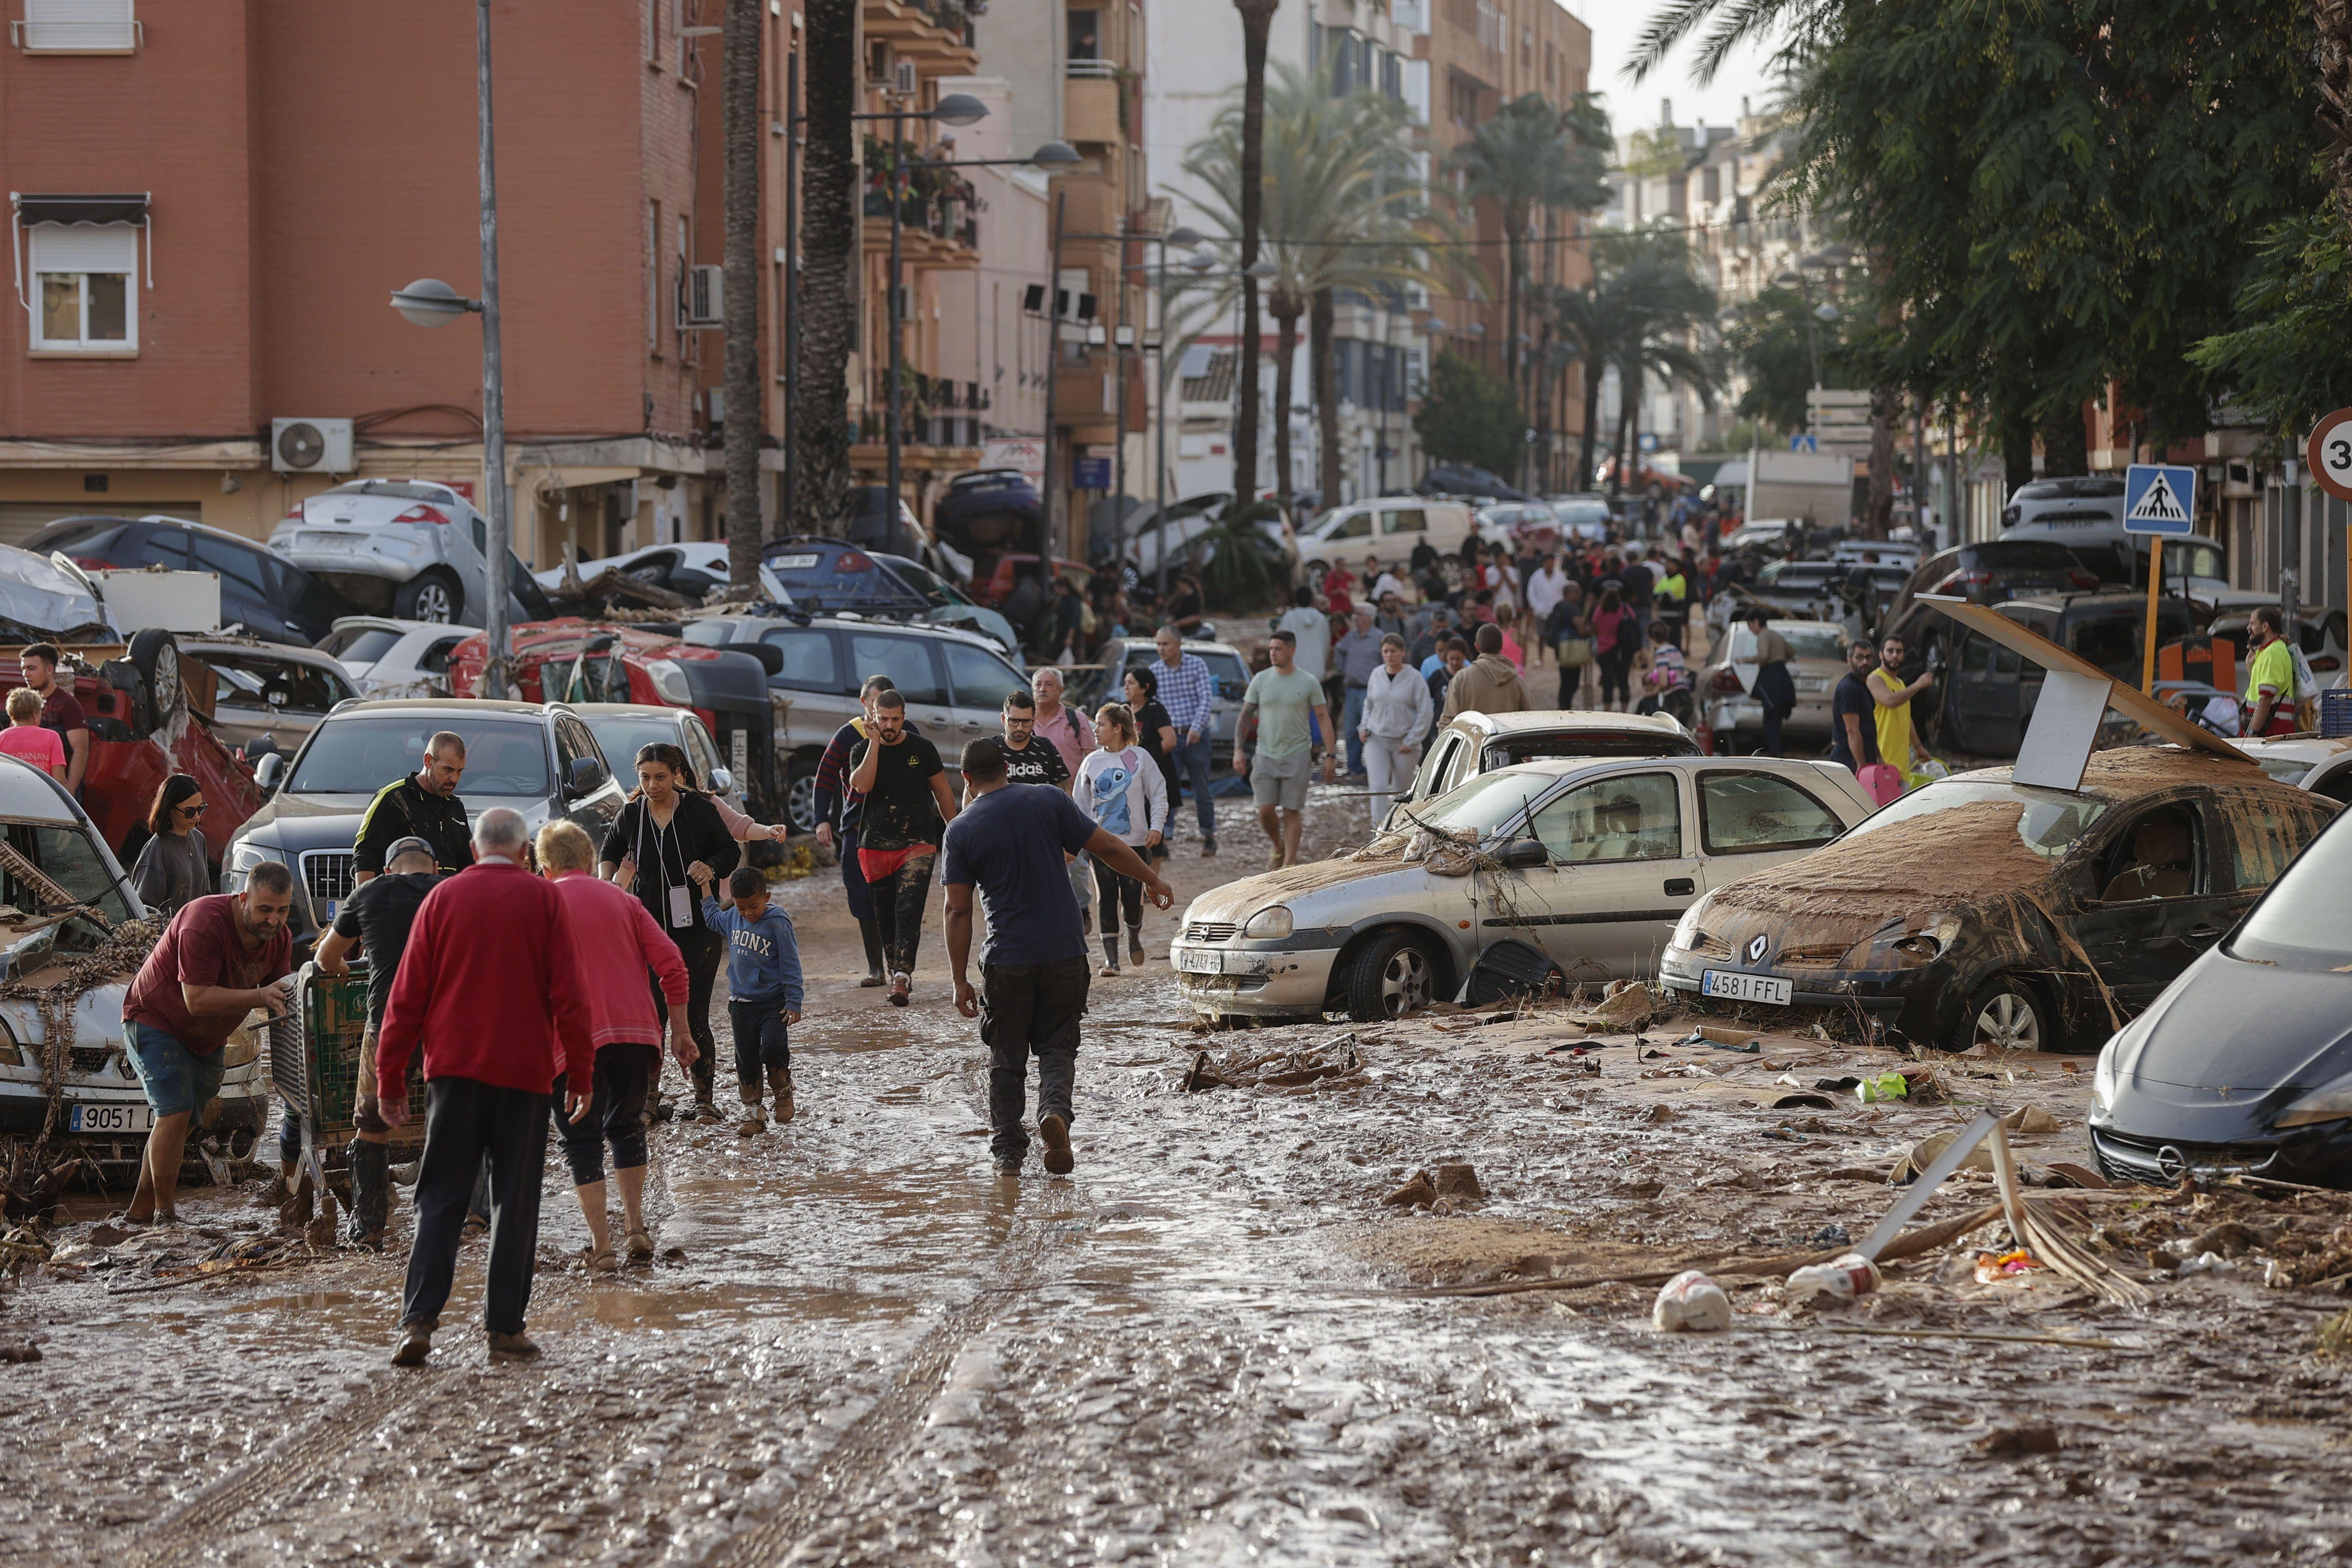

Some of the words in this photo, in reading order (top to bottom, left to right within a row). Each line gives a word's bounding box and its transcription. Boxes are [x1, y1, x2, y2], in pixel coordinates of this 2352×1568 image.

[733, 733, 744, 757] HFT
[1007, 763, 1044, 776] didas
[1712, 975, 1748, 996] 4581
[1754, 980, 1783, 1002] FFL
[86, 1108, 134, 1128] 9051
